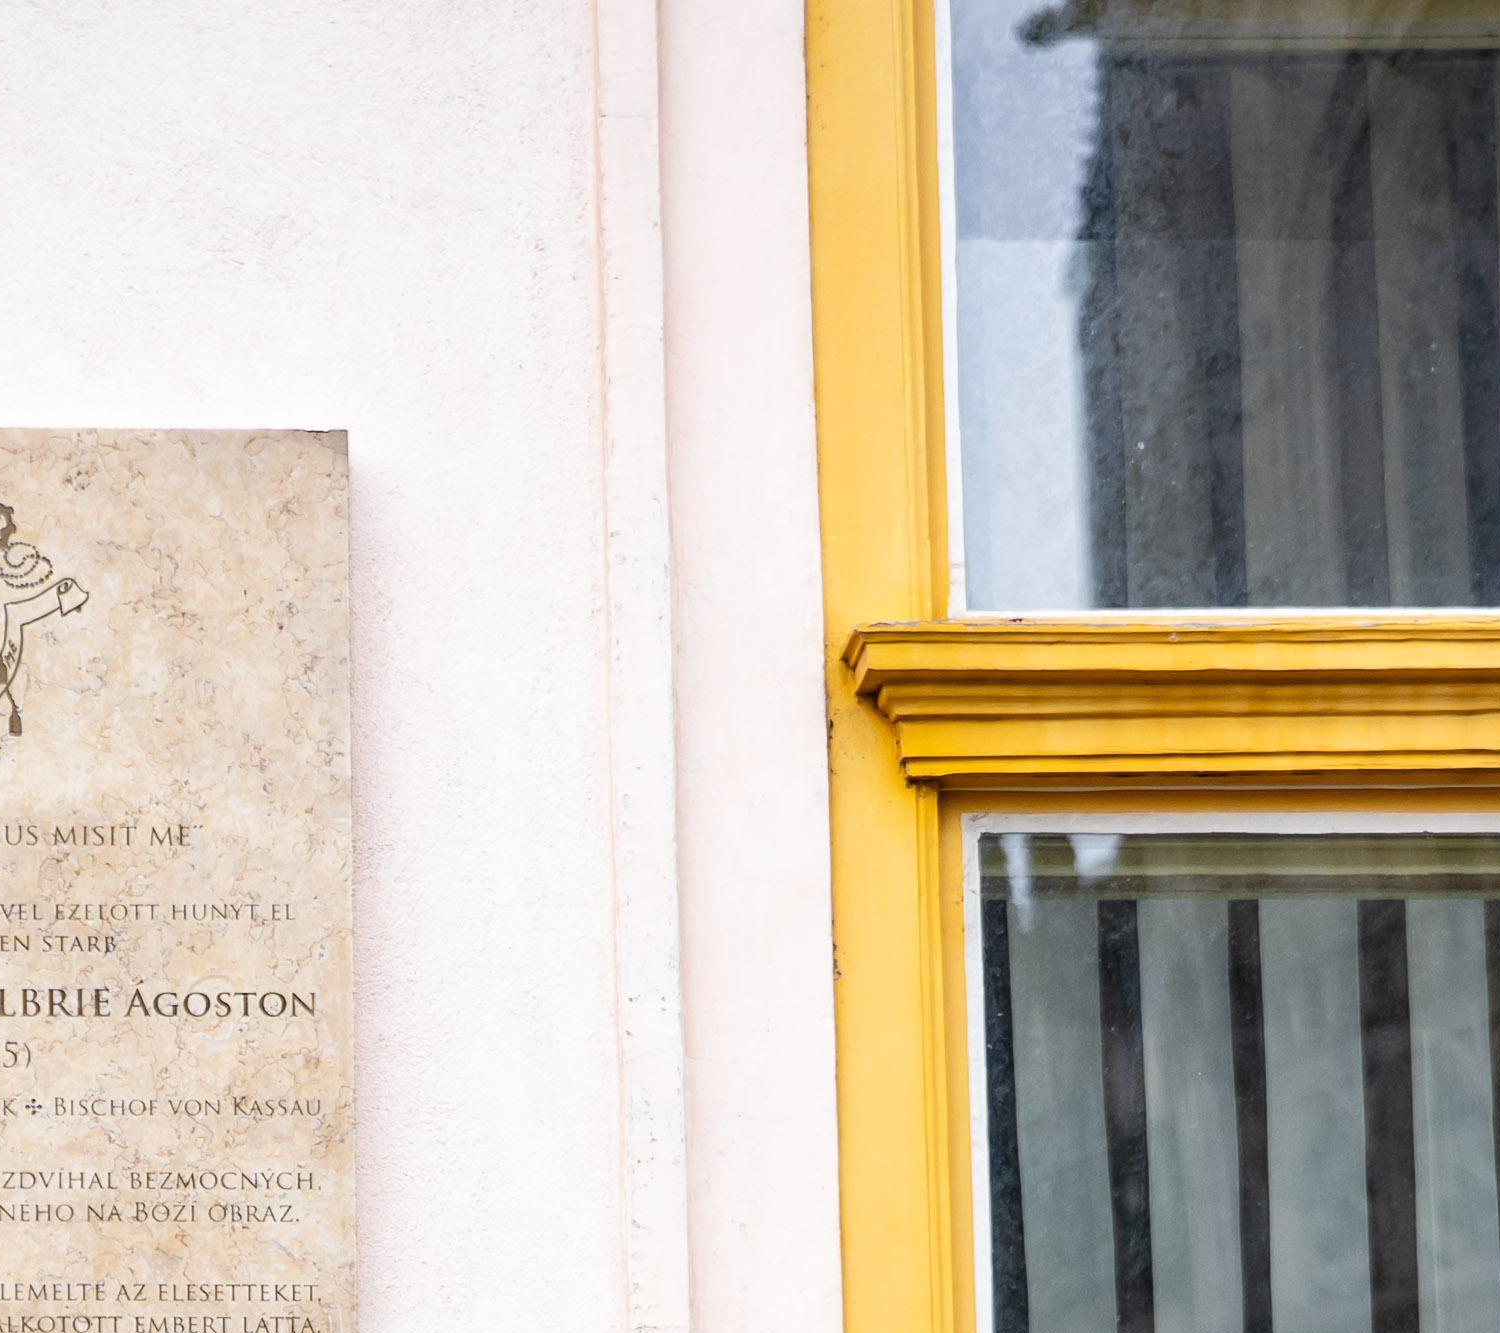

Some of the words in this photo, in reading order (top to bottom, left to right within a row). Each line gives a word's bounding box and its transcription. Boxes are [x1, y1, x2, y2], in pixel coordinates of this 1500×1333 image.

[52, 824, 138, 847] MISIT
[171, 903, 260, 922] HUNYT
[271, 903, 297, 922] EL
[41, 934, 117, 953] STARB
[125, 980, 317, 1019] ÁGOSTON
[53, 1097, 159, 1117] BISCHOF
[168, 1099, 222, 1117] VON
[233, 1097, 322, 1118] KASSAU
[1, 1168, 119, 1191] ZDVÍHAL
[207, 1204, 301, 1223] OBRAZ.
[115, 1284, 147, 1302] AZ
[157, 1284, 322, 1304] ELESETTEKET,
[135, 1315, 232, 1333] EMBERT
